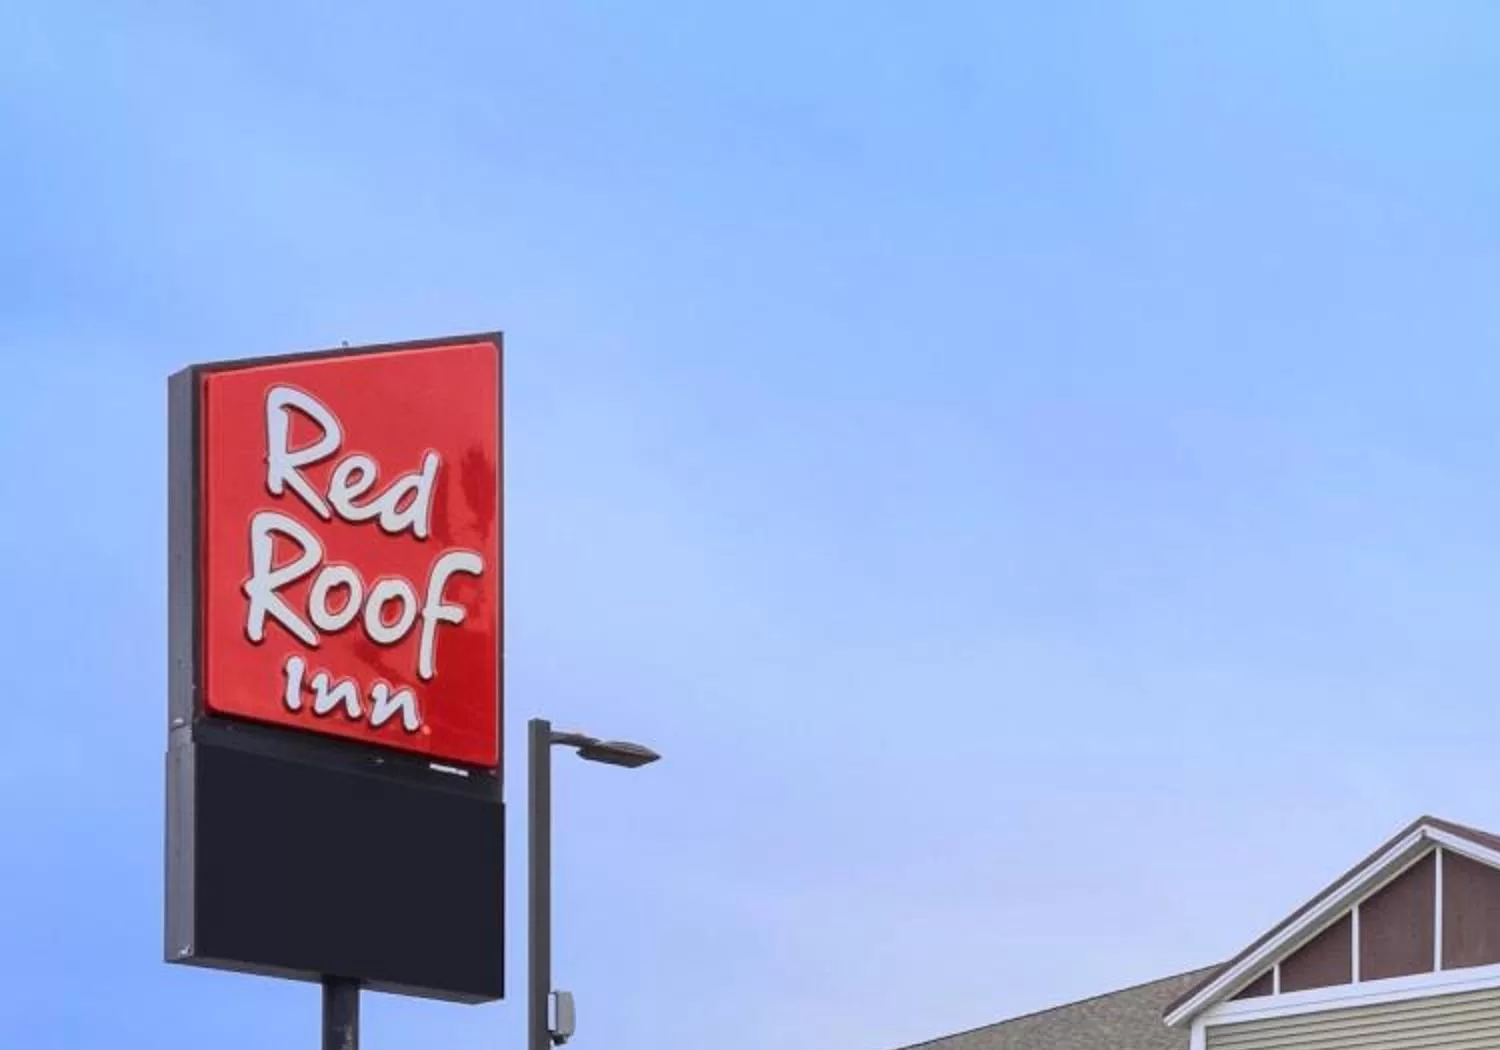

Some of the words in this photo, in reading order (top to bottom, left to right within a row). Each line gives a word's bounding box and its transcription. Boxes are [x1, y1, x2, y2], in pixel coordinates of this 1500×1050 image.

[266, 385, 440, 539] Red
[243, 511, 484, 680] Roof
[285, 655, 420, 731] Inn
